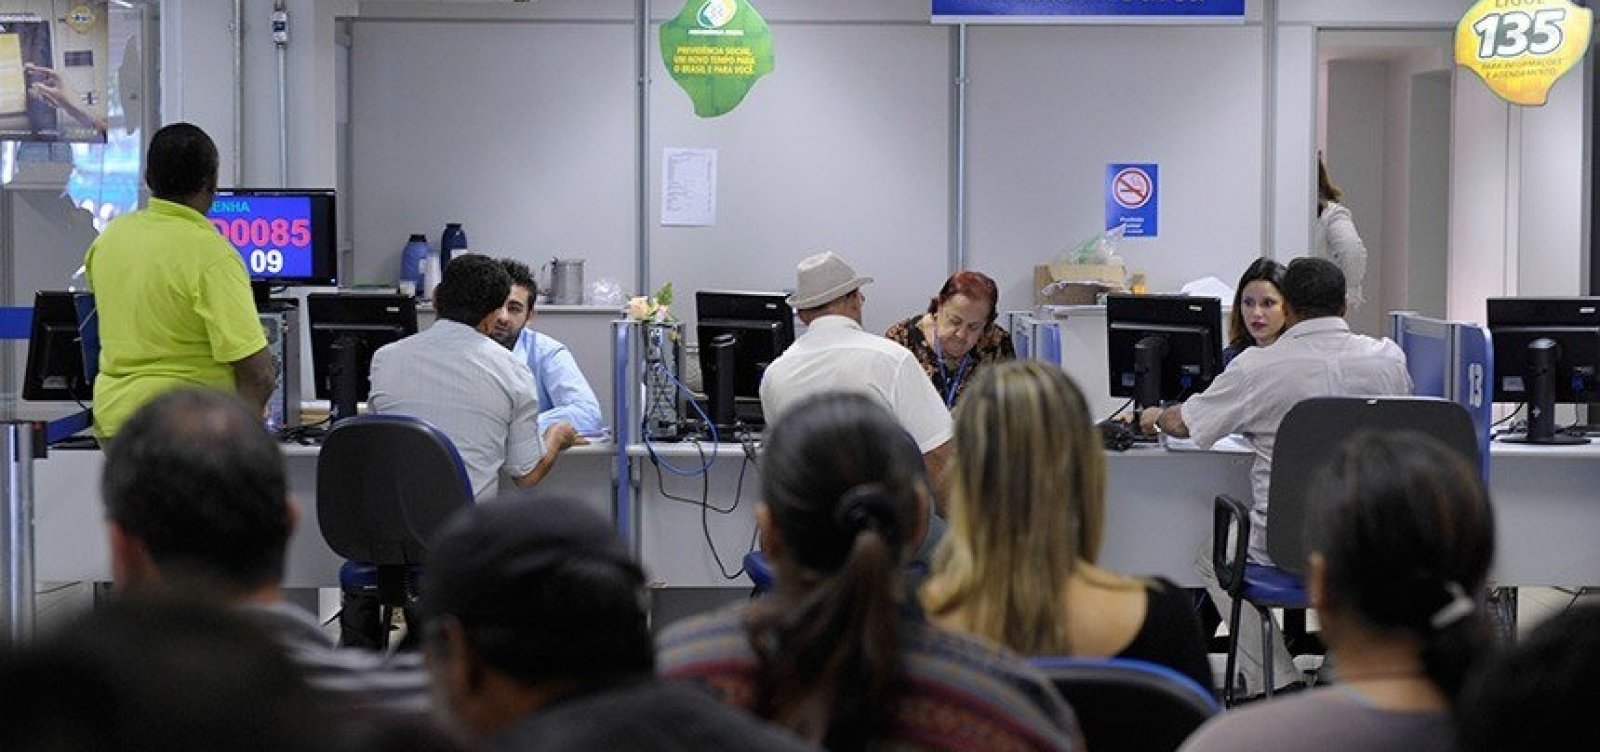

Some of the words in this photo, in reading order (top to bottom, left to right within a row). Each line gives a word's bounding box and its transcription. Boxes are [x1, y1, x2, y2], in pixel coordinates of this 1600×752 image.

[1473, 8, 1566, 58] 135
[676, 46, 724, 55] PREVIDÊNCIA
[687, 55, 709, 64] NOVO
[710, 55, 735, 64] TEMPO
[682, 65, 706, 73] BRASIL
[713, 65, 734, 74] PARA
[211, 200, 250, 213] ENHA
[250, 248, 284, 273] 09
